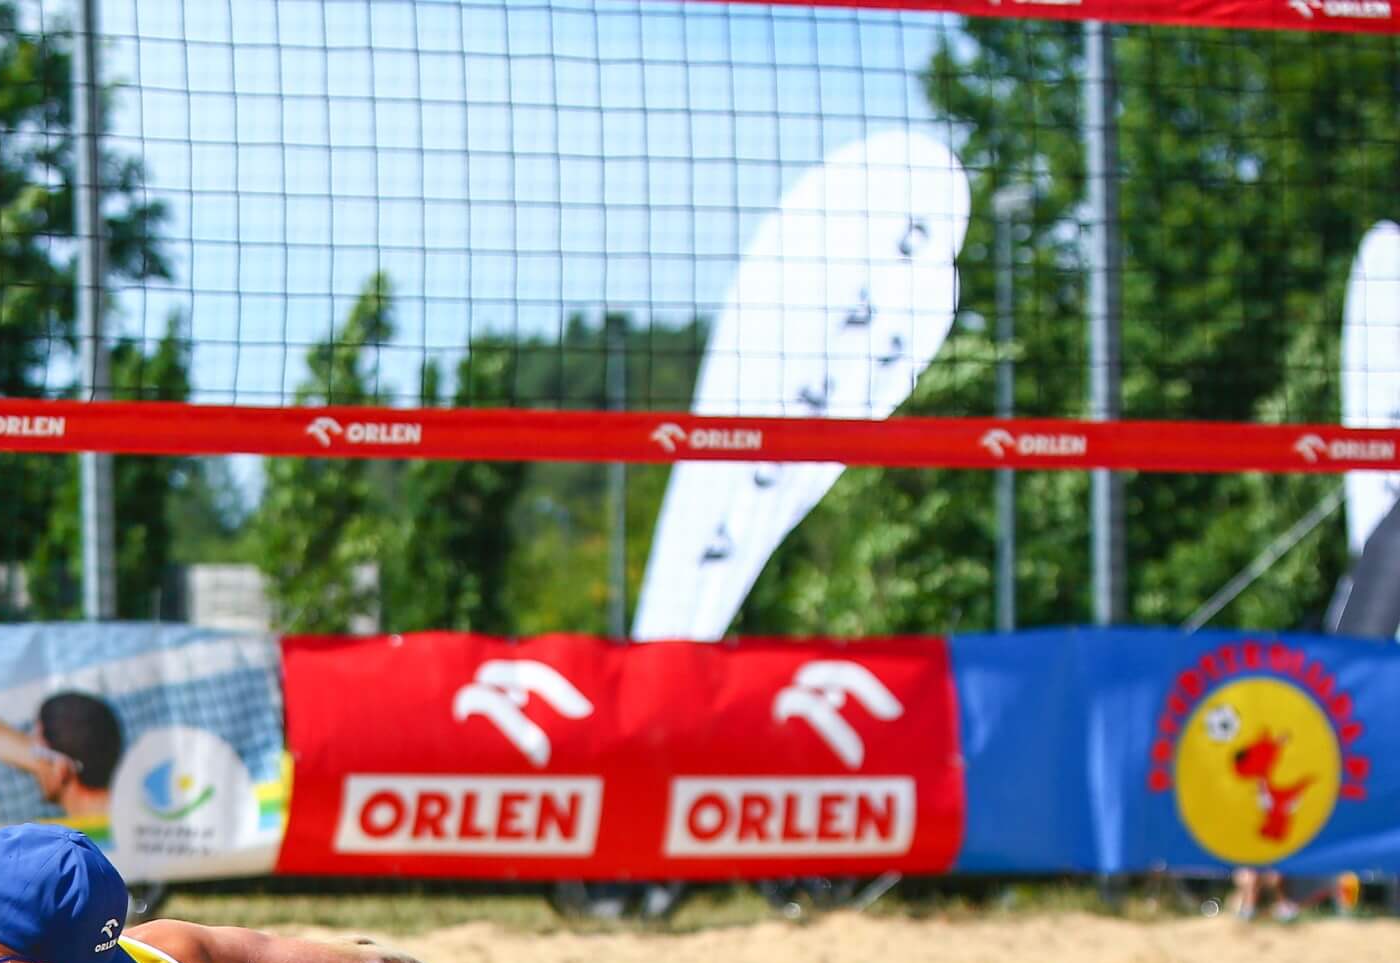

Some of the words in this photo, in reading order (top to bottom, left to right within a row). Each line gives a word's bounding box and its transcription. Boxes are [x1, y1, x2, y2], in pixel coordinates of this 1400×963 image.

[347, 423, 421, 444] ORLEN
[690, 429, 762, 450] ORLEN
[1017, 434, 1087, 455] ORLEN
[1330, 438, 1395, 460] ORLEN
[359, 791, 581, 840] ORLEN
[688, 794, 895, 842] ORLEN
